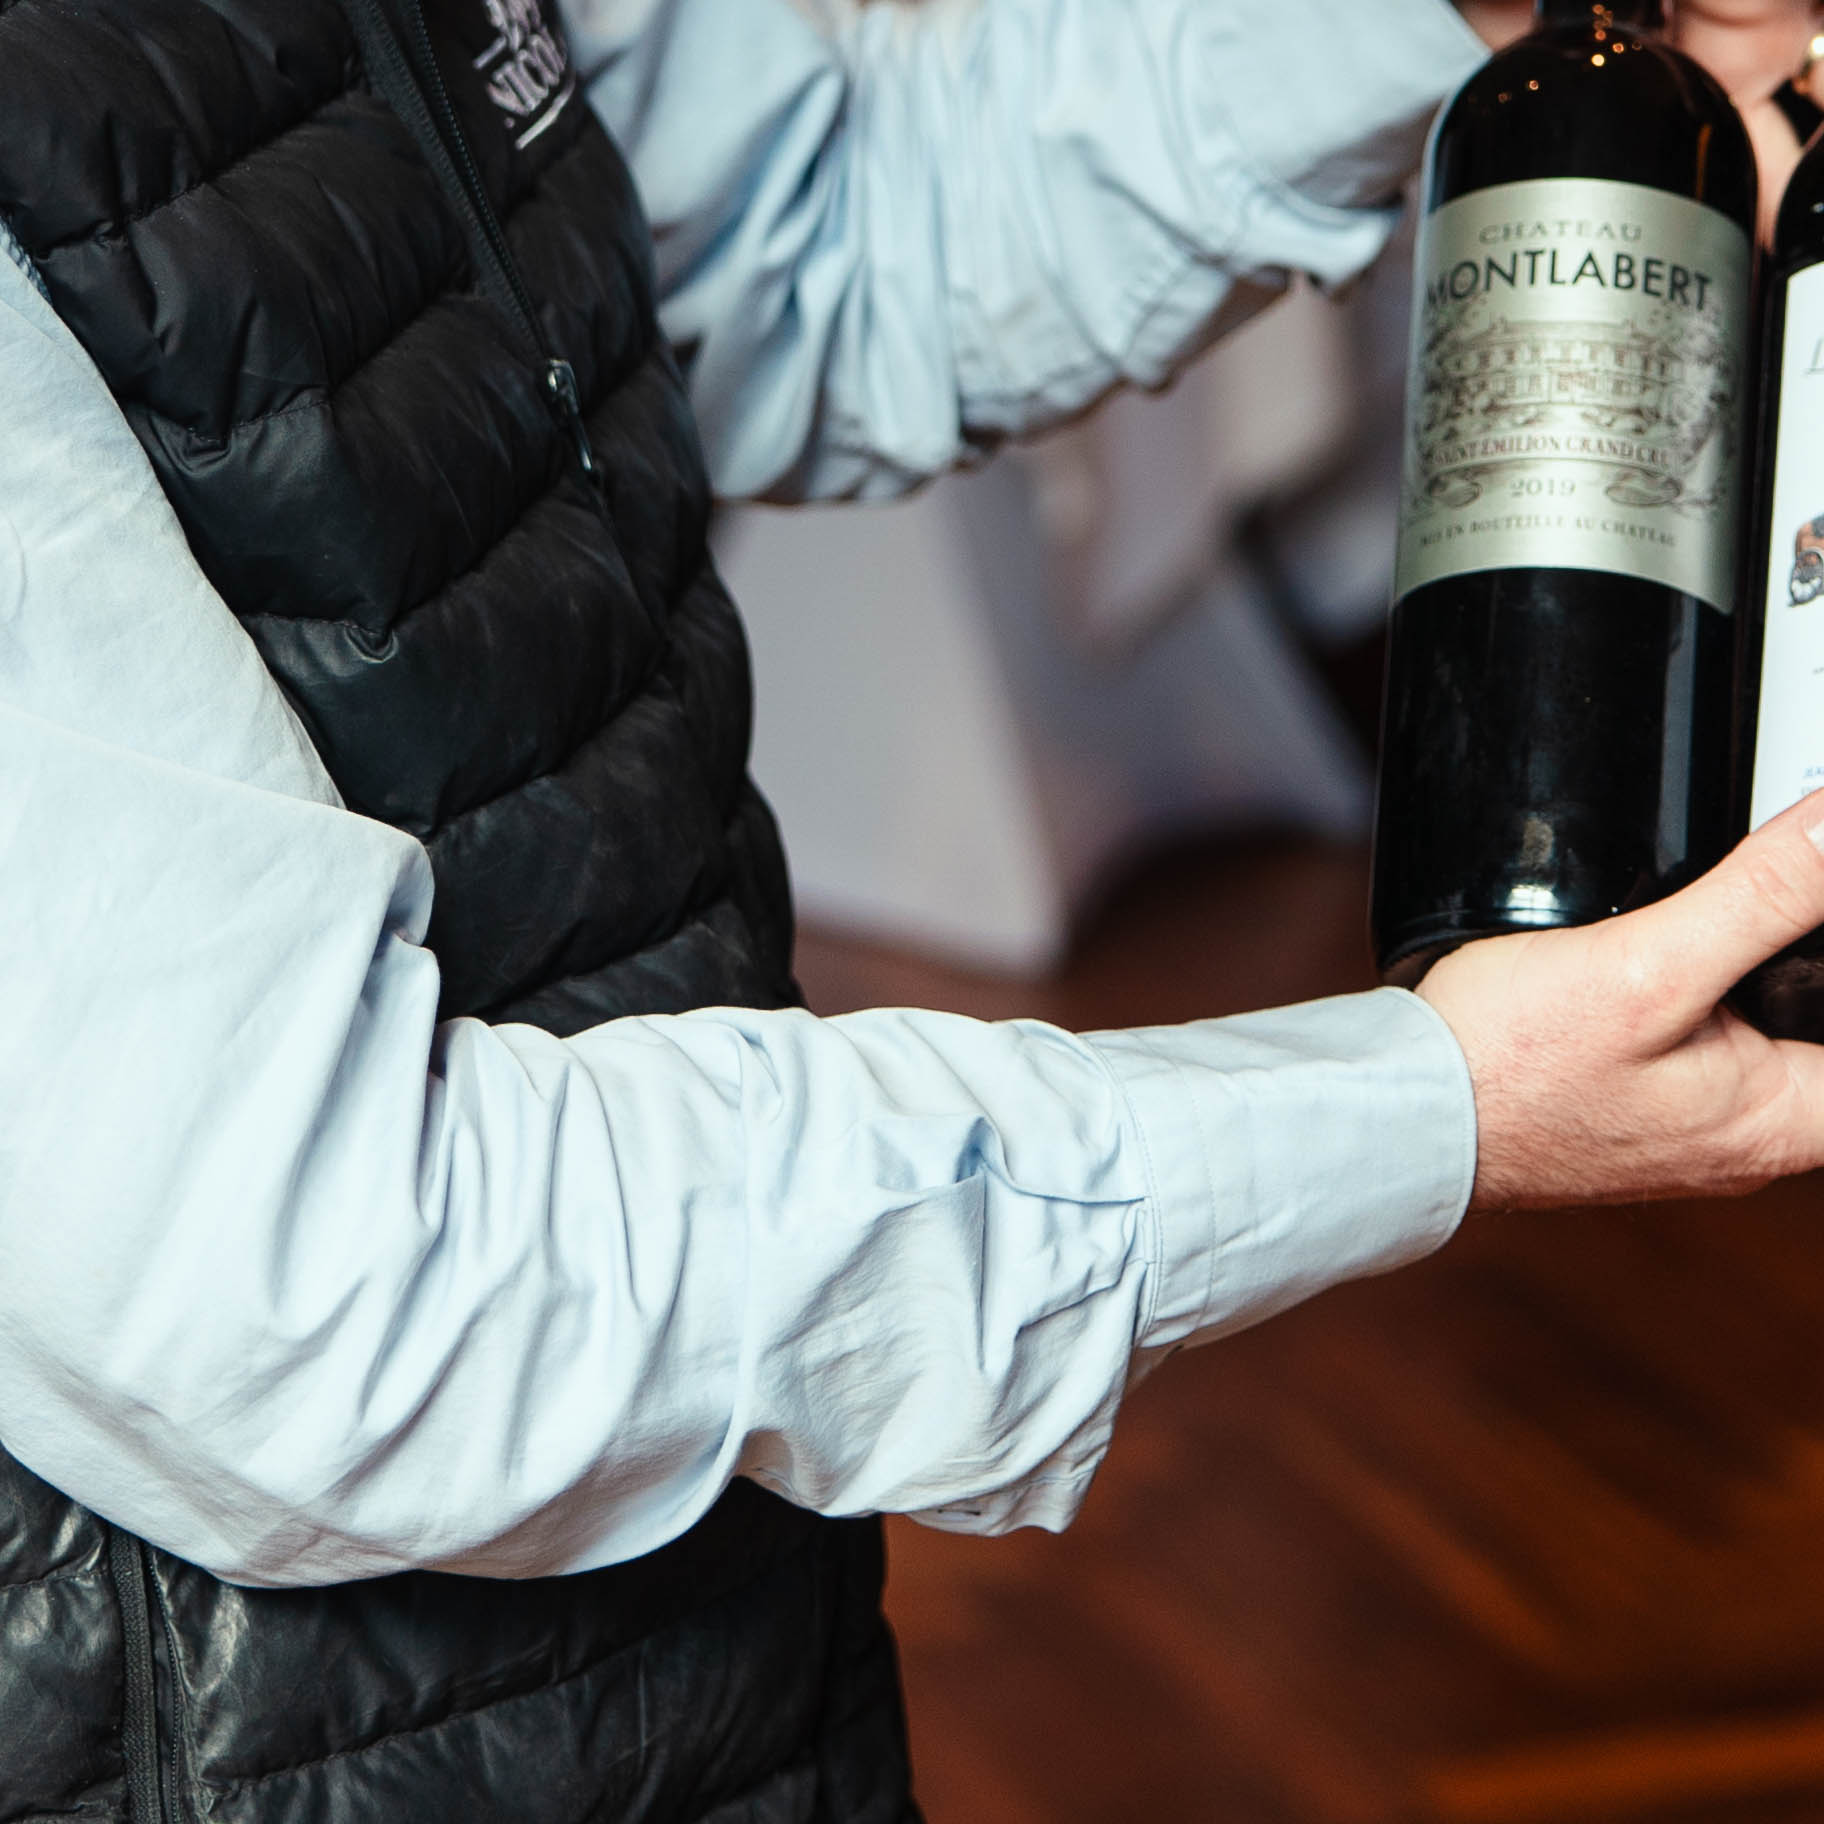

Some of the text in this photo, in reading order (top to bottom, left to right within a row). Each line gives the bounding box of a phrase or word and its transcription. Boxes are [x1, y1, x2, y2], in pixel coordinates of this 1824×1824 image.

[1426, 248, 1713, 312] MONTLABERT
[1565, 434, 1635, 458] GRAND
[1509, 477, 1576, 497] 2019
